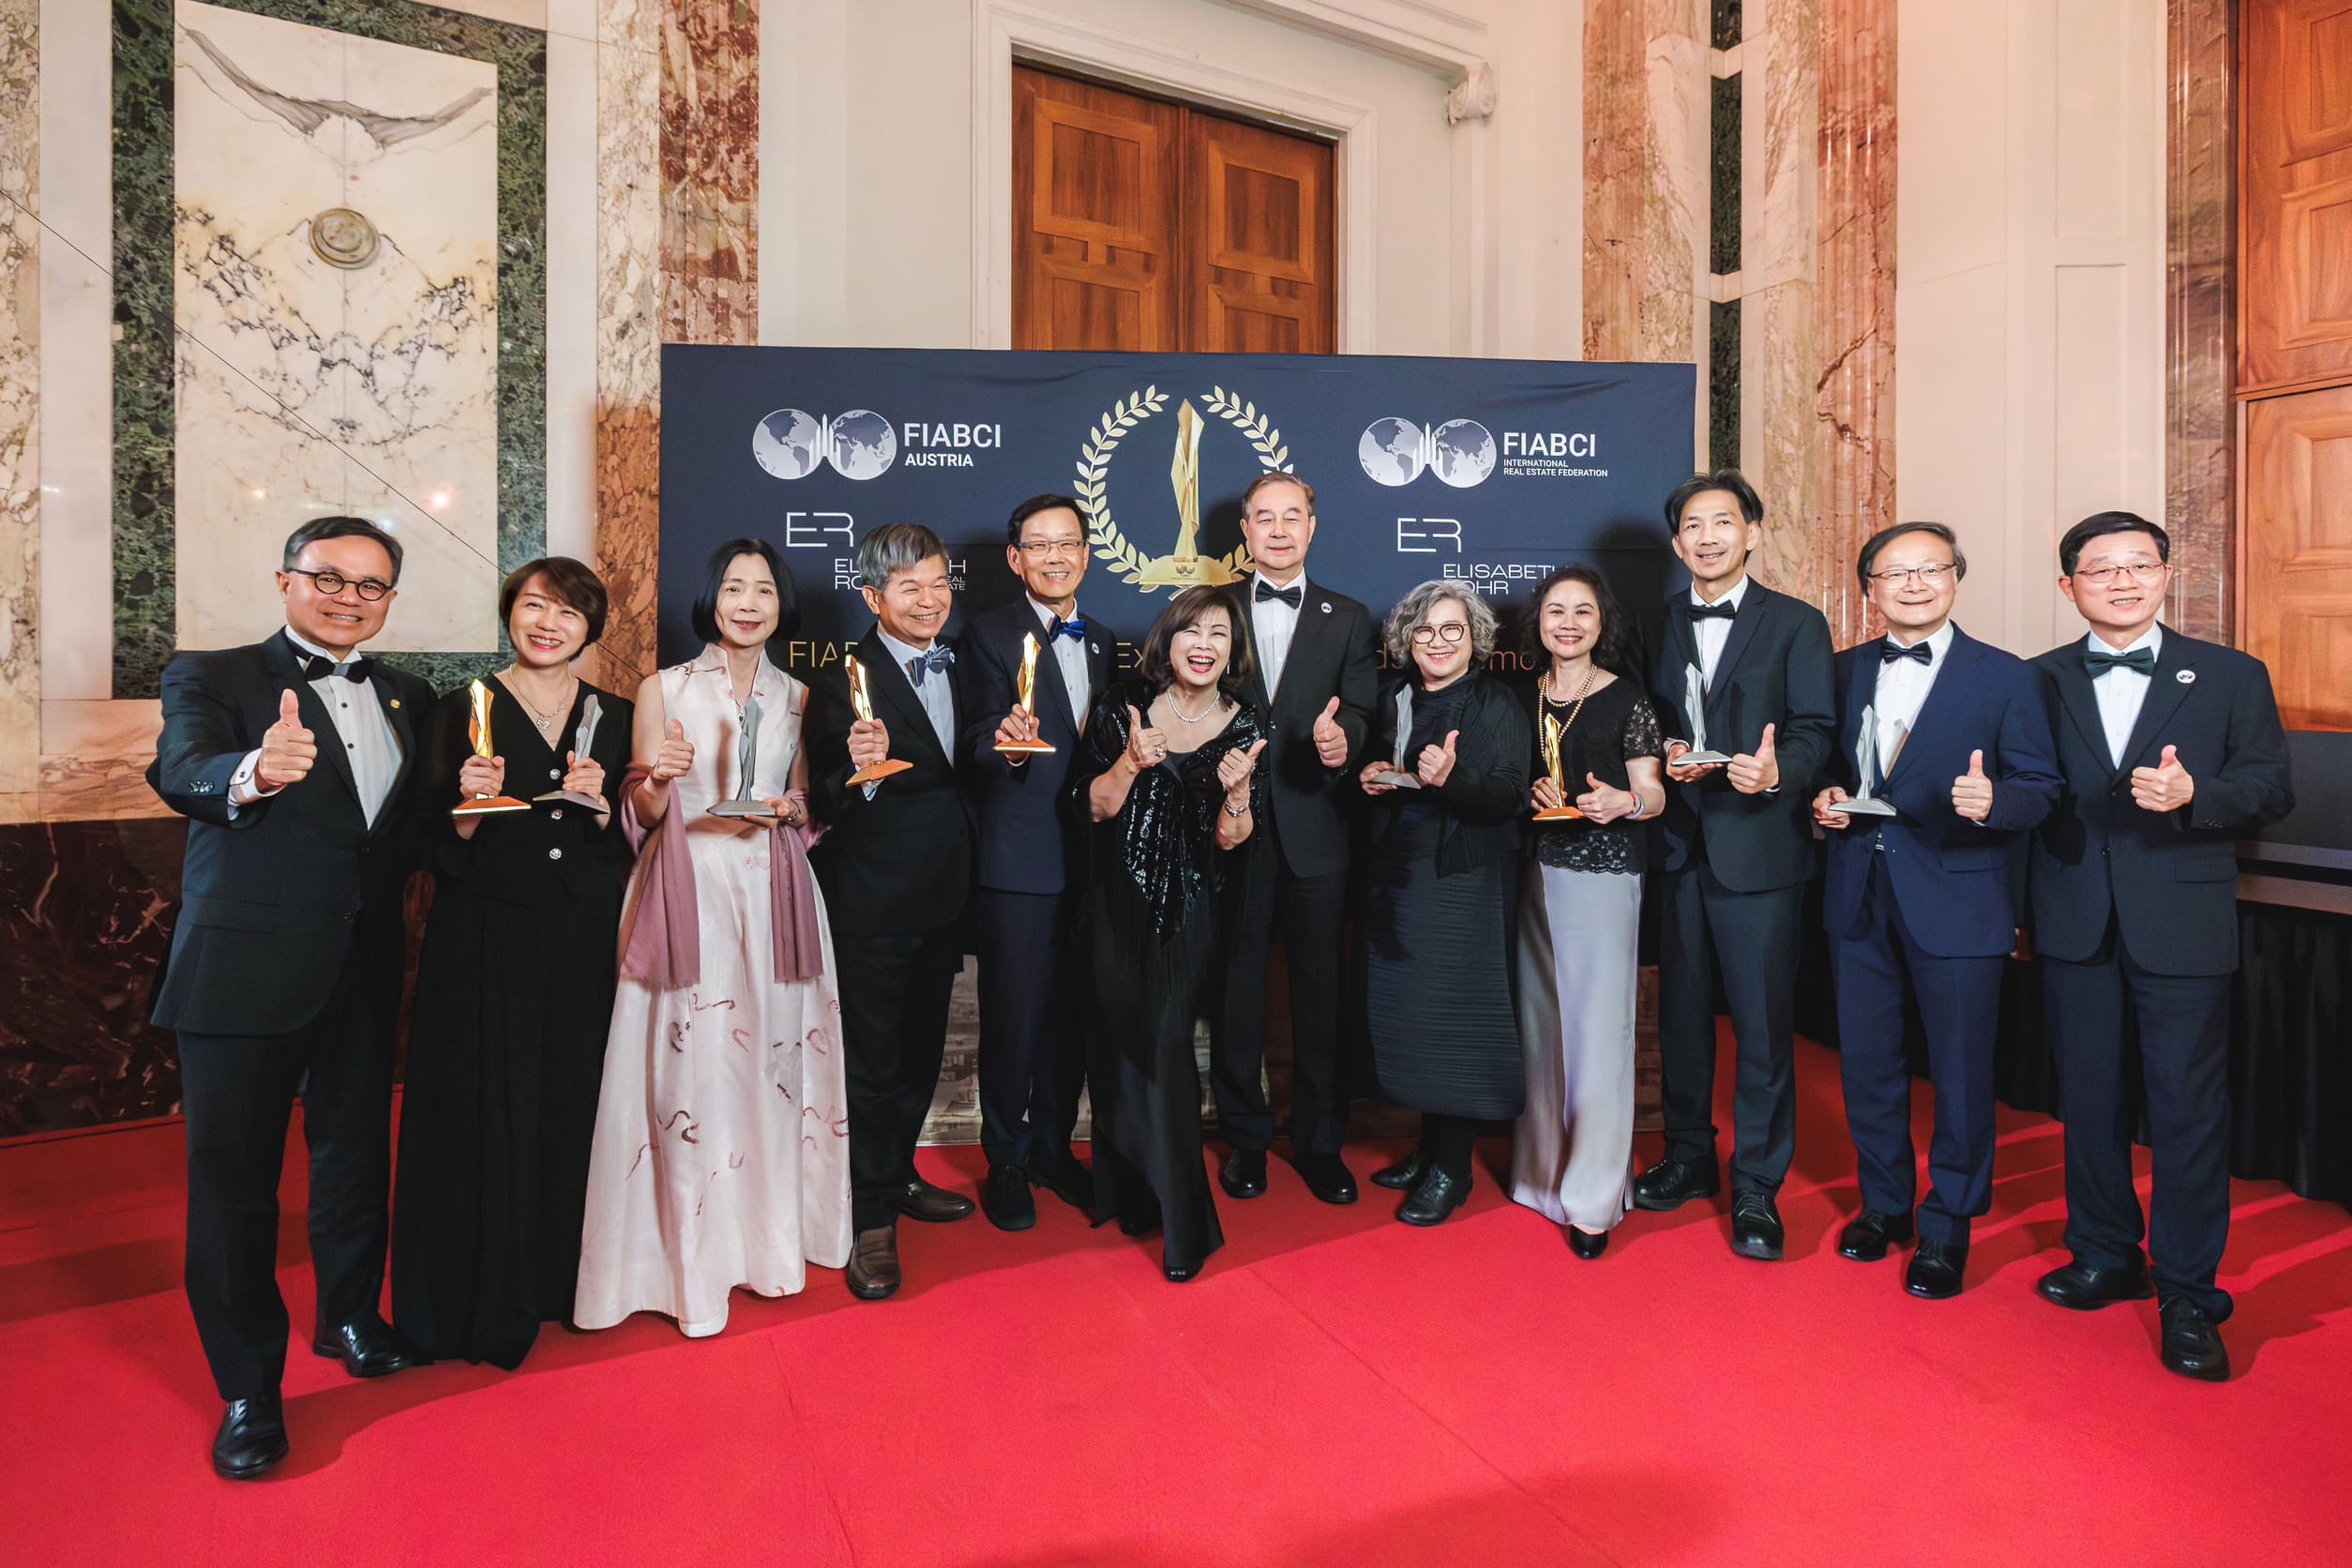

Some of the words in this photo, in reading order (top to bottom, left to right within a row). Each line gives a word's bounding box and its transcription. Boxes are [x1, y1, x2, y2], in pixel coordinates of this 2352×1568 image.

[903, 423, 1003, 448] FIABCI
[1503, 432, 1596, 458] FIABCI
[904, 454, 974, 468] AUSTRIA
[1503, 459, 1569, 468] INTERNATIONAL
[1503, 468, 1525, 476] REAL
[1526, 468, 1557, 477] ESTATE
[1558, 469, 1608, 477] FEDERATION
[786, 512, 854, 548] ER
[1397, 518, 1462, 553] ER
